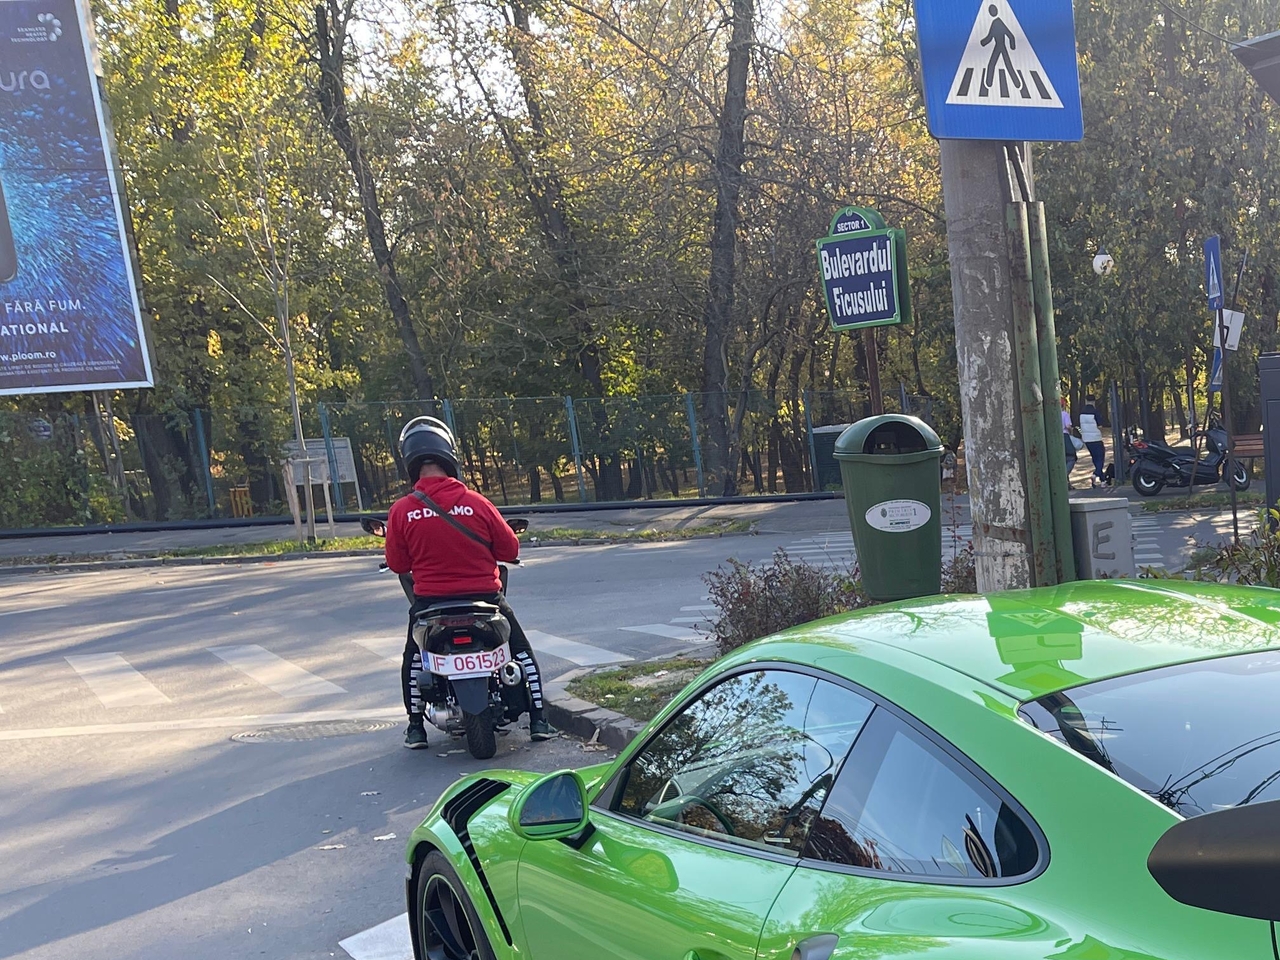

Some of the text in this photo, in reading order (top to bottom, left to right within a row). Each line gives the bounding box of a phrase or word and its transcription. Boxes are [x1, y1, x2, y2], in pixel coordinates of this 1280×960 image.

[837, 220, 865, 232] SECTOR 1
[821, 240, 891, 280] Bulevardul
[5, 299, 86, 314] FĂRĂ FUM.
[833, 280, 888, 317] Ficusului
[406, 509, 422, 522] FC
[454, 647, 506, 671] 061523
